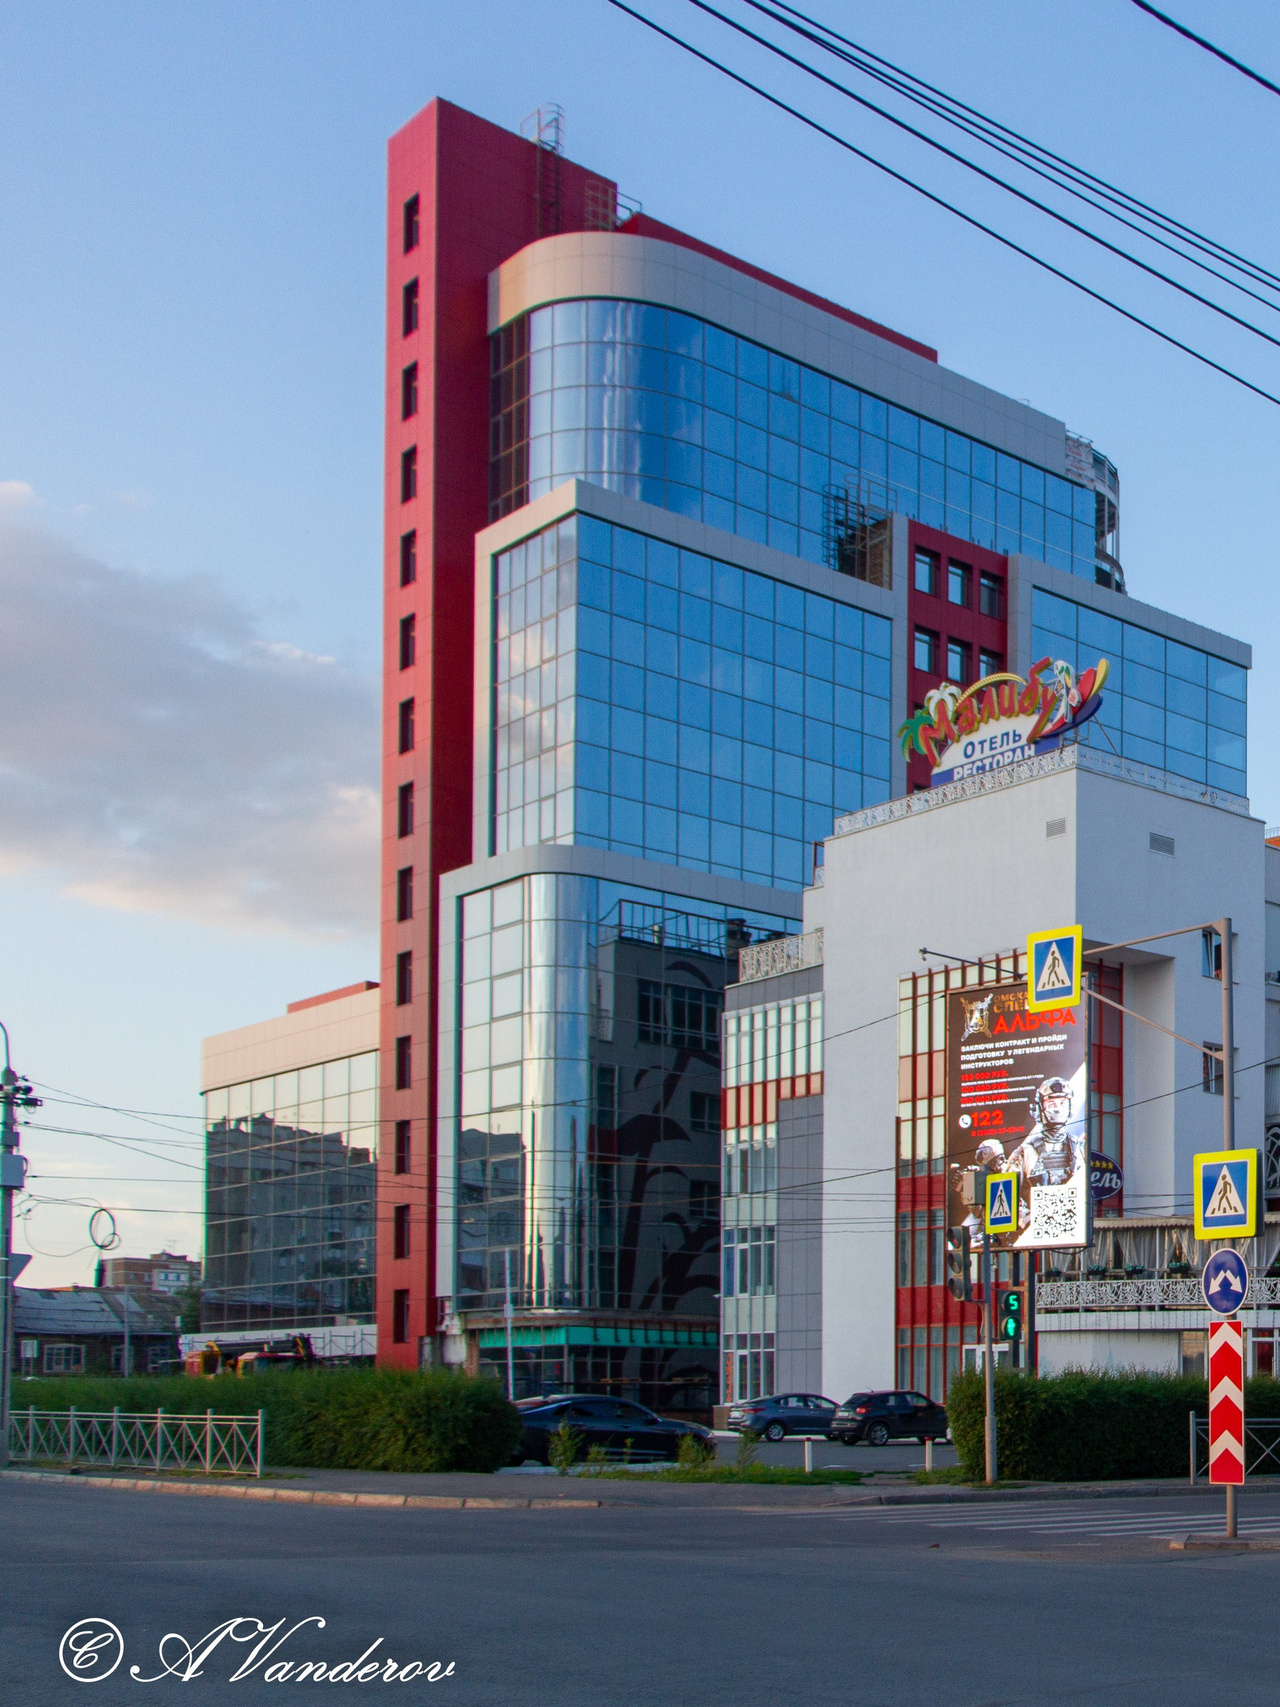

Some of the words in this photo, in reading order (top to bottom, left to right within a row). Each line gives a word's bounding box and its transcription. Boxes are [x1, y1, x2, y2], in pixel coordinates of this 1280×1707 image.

[918, 656, 1057, 767] Малибу
[963, 729, 1022, 759] ОТЕЛЬ
[953, 744, 1035, 780] РЕСТОРАН
[993, 991, 1029, 1003] ОМСКА
[993, 999, 1030, 1013] СПЕ
[992, 1007, 1077, 1035] АЛЬФА
[960, 1042, 995, 1052] ЗАКЛЮЧИ
[995, 1038, 1031, 1048] КОНТРАКТ
[1038, 1034, 1068, 1043] ПРОЙДИ
[960, 1050, 1005, 1061] ПОДГОТОВКУ
[1013, 1043, 1065, 1055] ЛЕГЕНДАРНЫХ
[960, 1058, 1014, 1070] ИНСТРУКТОРОВ
[970, 1109, 1004, 1127] 122
[1090, 1171, 1121, 1189] ель
[1009, 1294, 1019, 1310] 5
